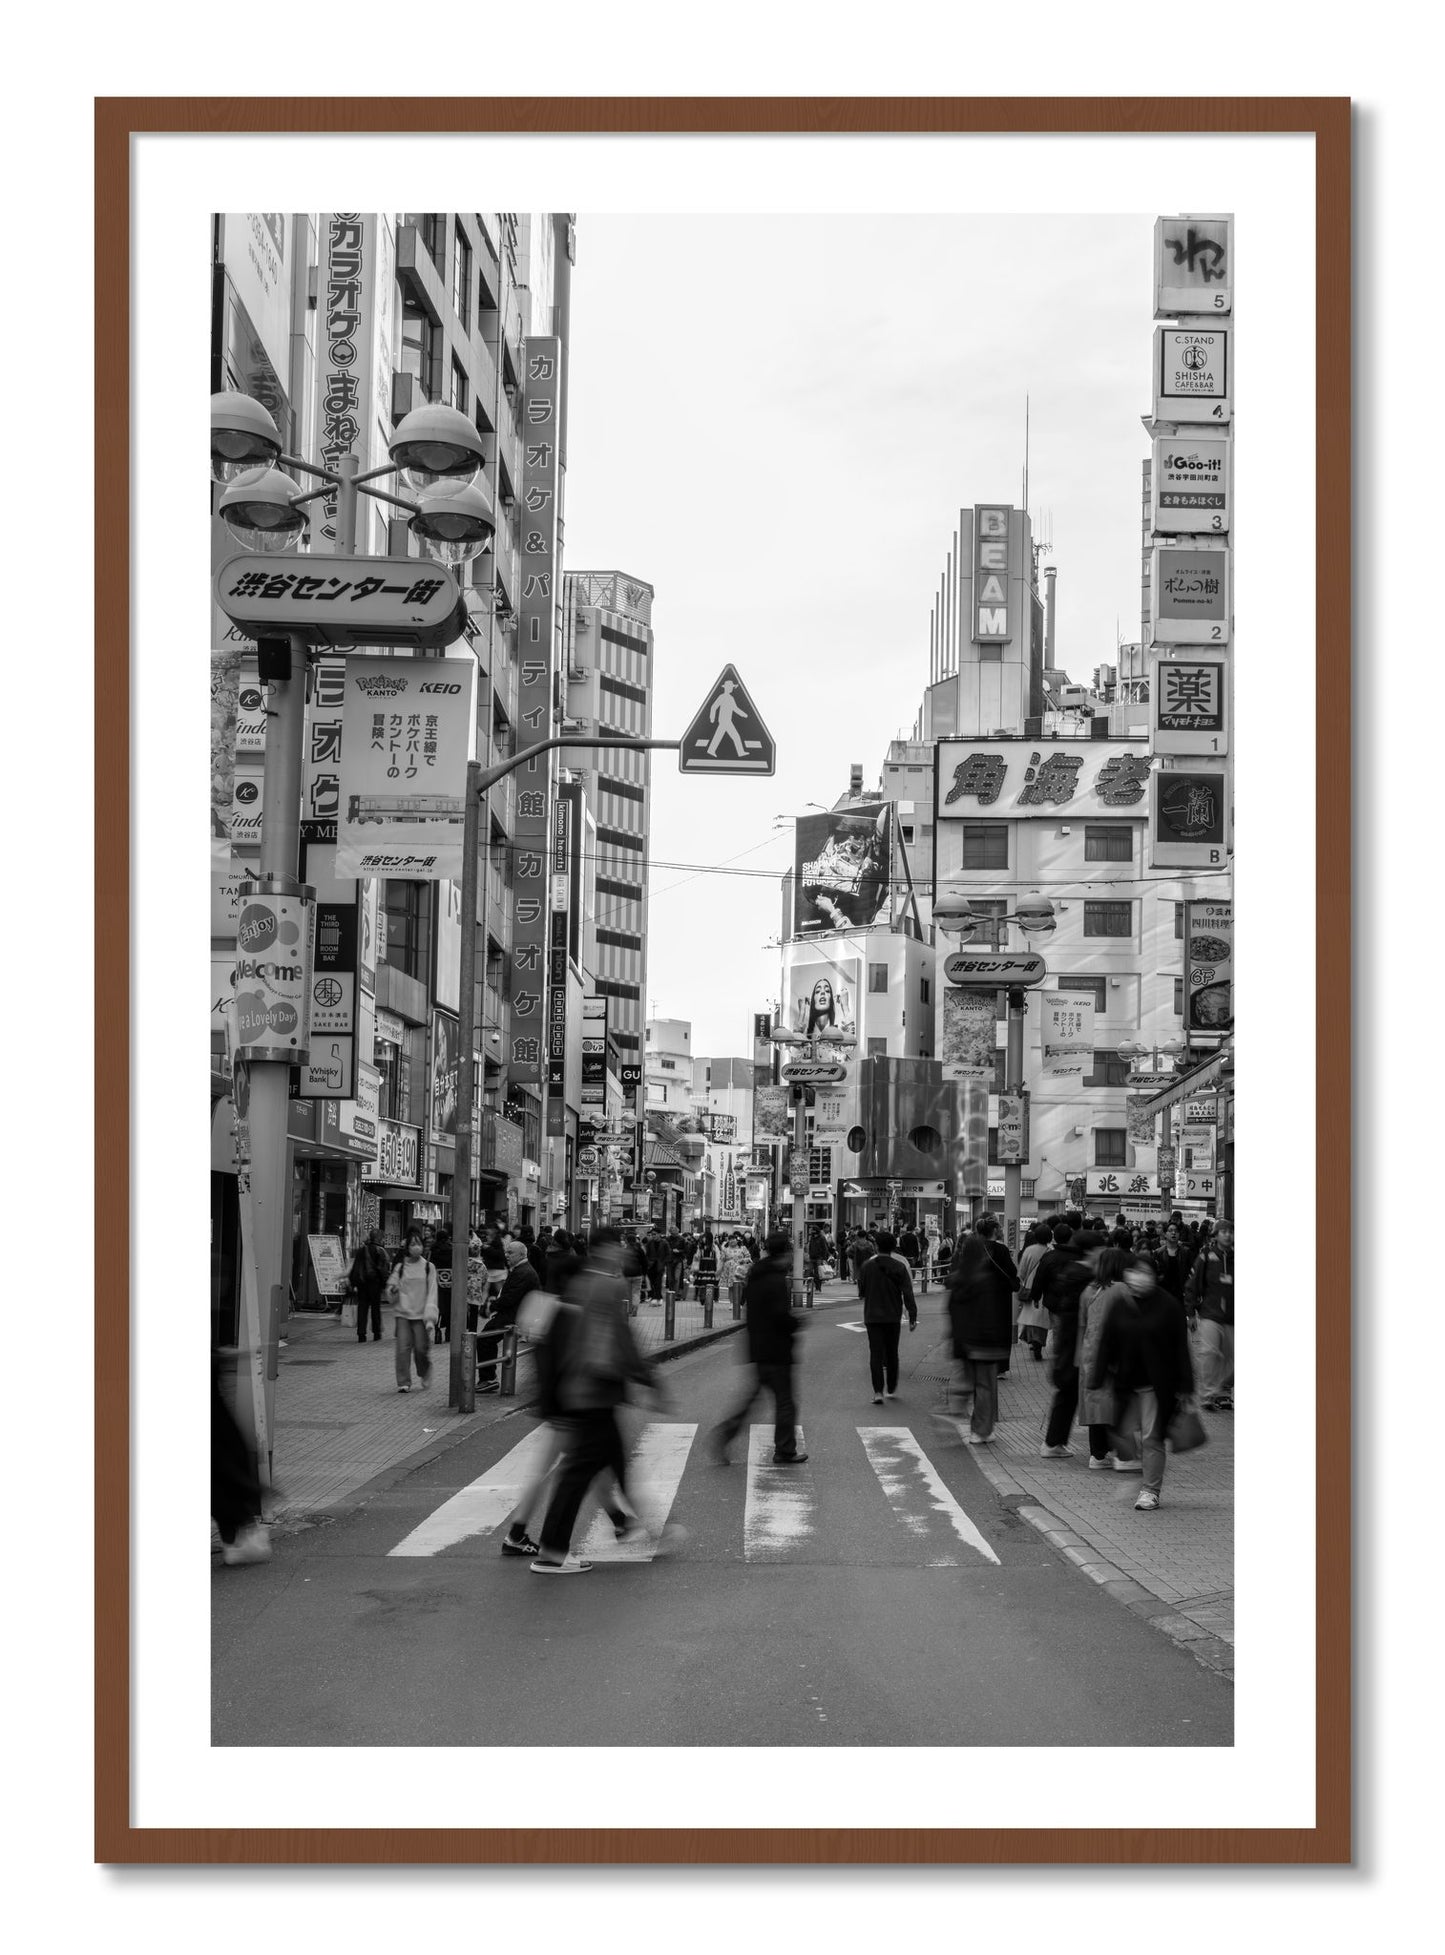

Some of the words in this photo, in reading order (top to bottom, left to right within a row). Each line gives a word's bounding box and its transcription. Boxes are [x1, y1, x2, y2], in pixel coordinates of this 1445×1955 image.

[326, 220, 364, 341] カラオケ
[1213, 295, 1225, 308] 5
[1174, 336, 1215, 345] C.STAND
[1175, 371, 1214, 381] SHISHA
[1174, 381, 1214, 389] CAFE&BAR
[1173, 456, 1222, 471] Goo-it!
[1163, 495, 1222, 506] 全身もみほぐし
[1211, 515, 1222, 530] 3
[979, 509, 1007, 635] BEAM
[228, 572, 446, 605] 渋谷センター街
[1164, 577, 1220, 594] ポムの樹
[1211, 626, 1222, 640] 2
[366, 689, 398, 697] KANTO
[419, 682, 462, 695] KEIO
[1166, 668, 1211, 713] 薬
[1161, 715, 1216, 728] マツモトキヨシ
[240, 738, 262, 746] 渋谷店
[387, 713, 402, 779] カントーの
[405, 714, 421, 779] ポケパーク
[423, 715, 439, 767] 京王線で
[1210, 738, 1218, 751] 1
[944, 751, 1155, 806] 角海老
[1161, 785, 1215, 829] 一蘭
[556, 803, 565, 836] kimono
[236, 831, 258, 839] 渋谷店
[360, 854, 438, 867] 渋谷センター街
[1209, 850, 1220, 864] B
[239, 915, 275, 946] Enjoy
[237, 959, 303, 981] Welcome
[950, 960, 1041, 973] 渋谷センター街
[1190, 968, 1216, 985] 6F
[251, 1009, 279, 1028] Lovely
[278, 1010, 297, 1024] Day!
[309, 1067, 339, 1077] Whisky
[623, 1070, 641, 1080] GU
[784, 1067, 839, 1076] 渋谷センター街
[309, 1075, 327, 1083] Bank
[726, 1172, 734, 1210] BEER
